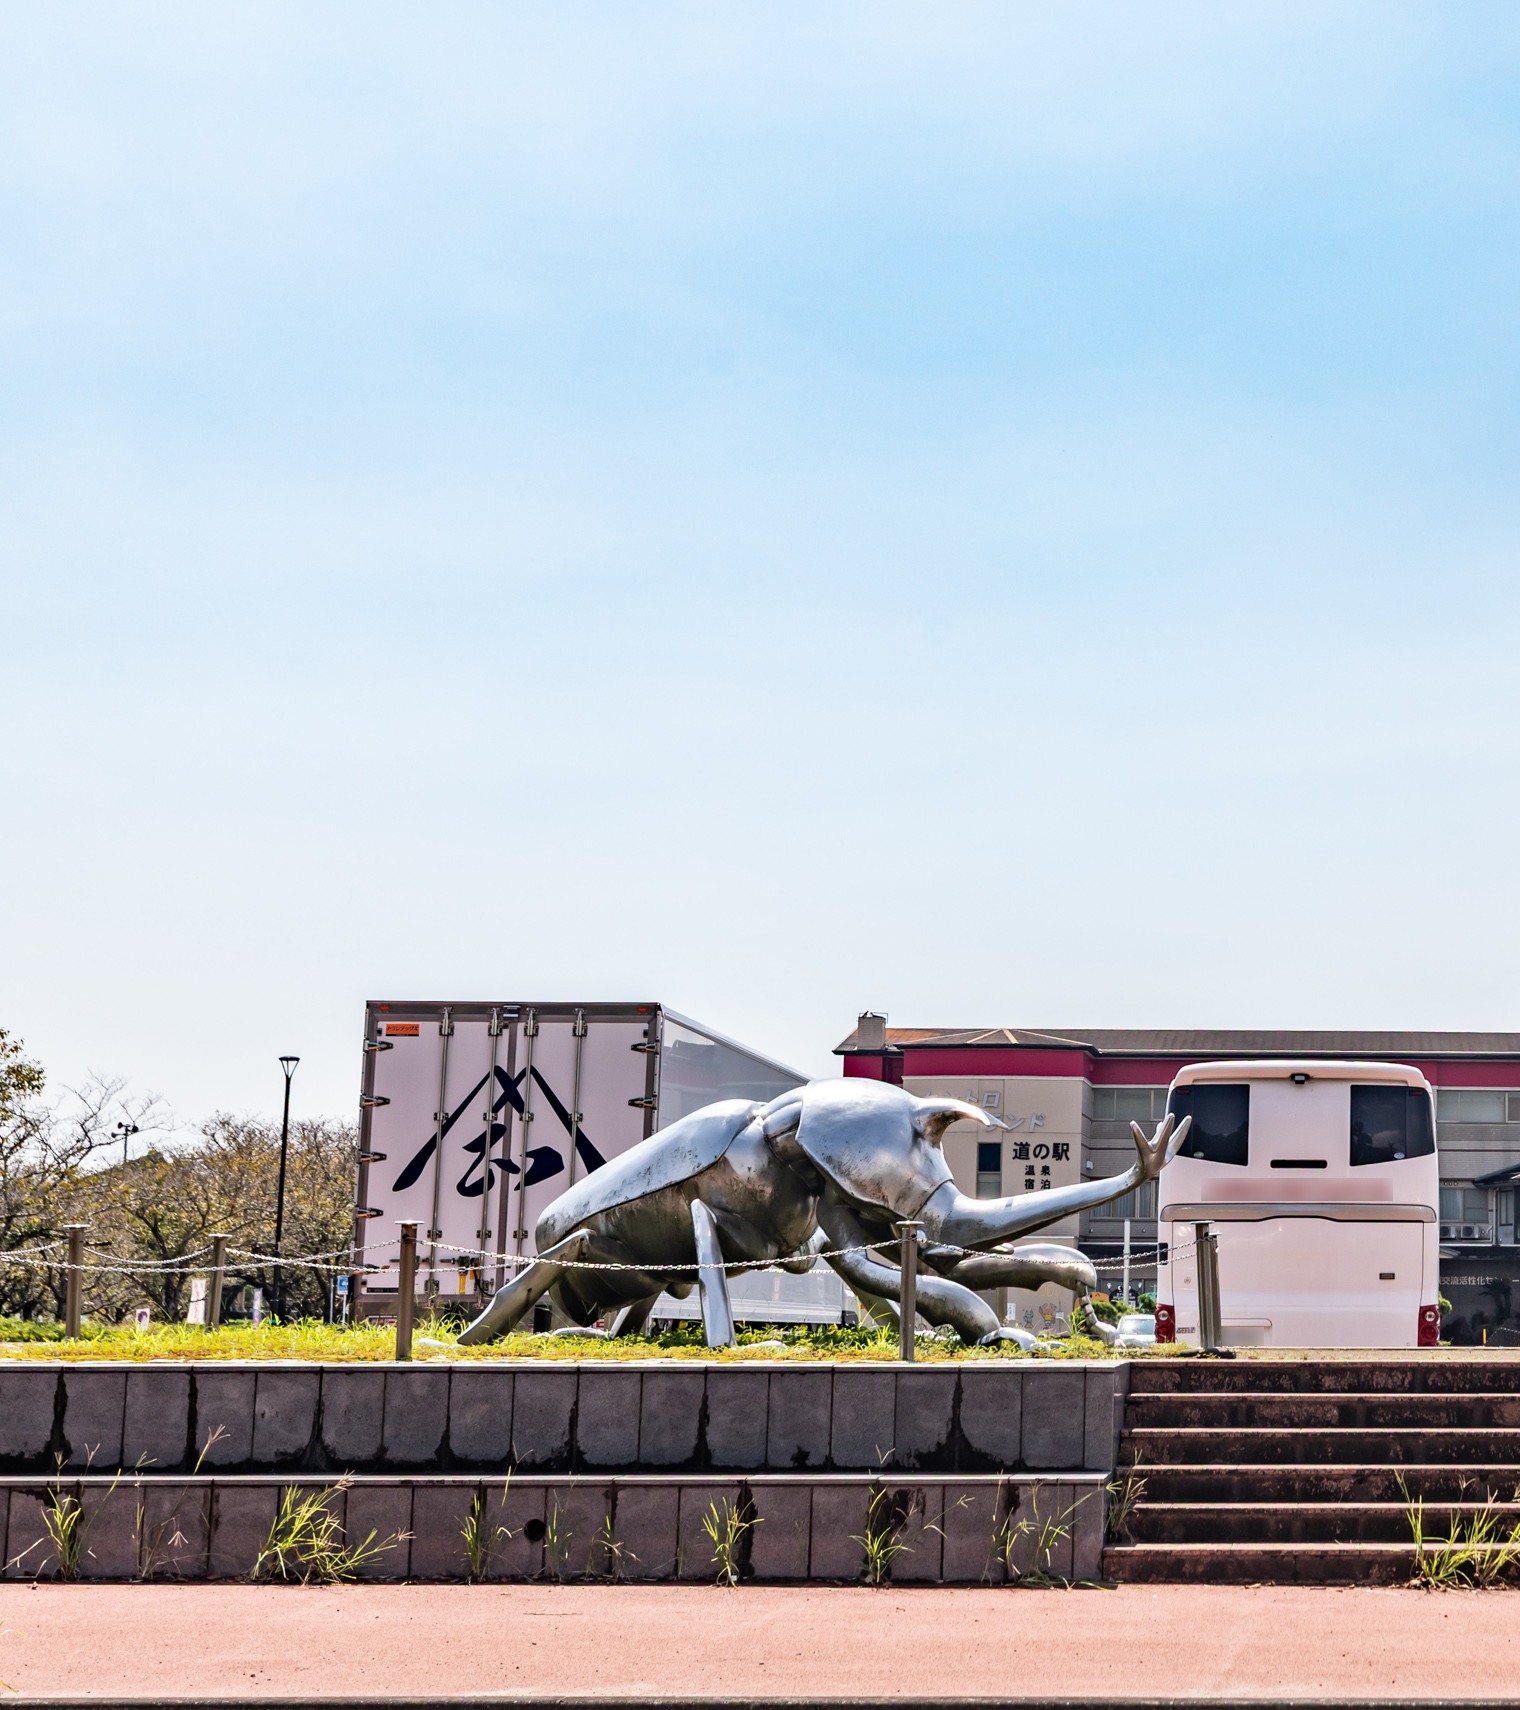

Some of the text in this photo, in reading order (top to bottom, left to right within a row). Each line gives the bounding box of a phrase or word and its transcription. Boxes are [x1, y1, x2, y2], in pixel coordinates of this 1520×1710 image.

[1012, 1142, 1070, 1161] 道の駅
[1024, 1165, 1051, 1176] 温泉
[1024, 1179, 1051, 1190] 宿泊
